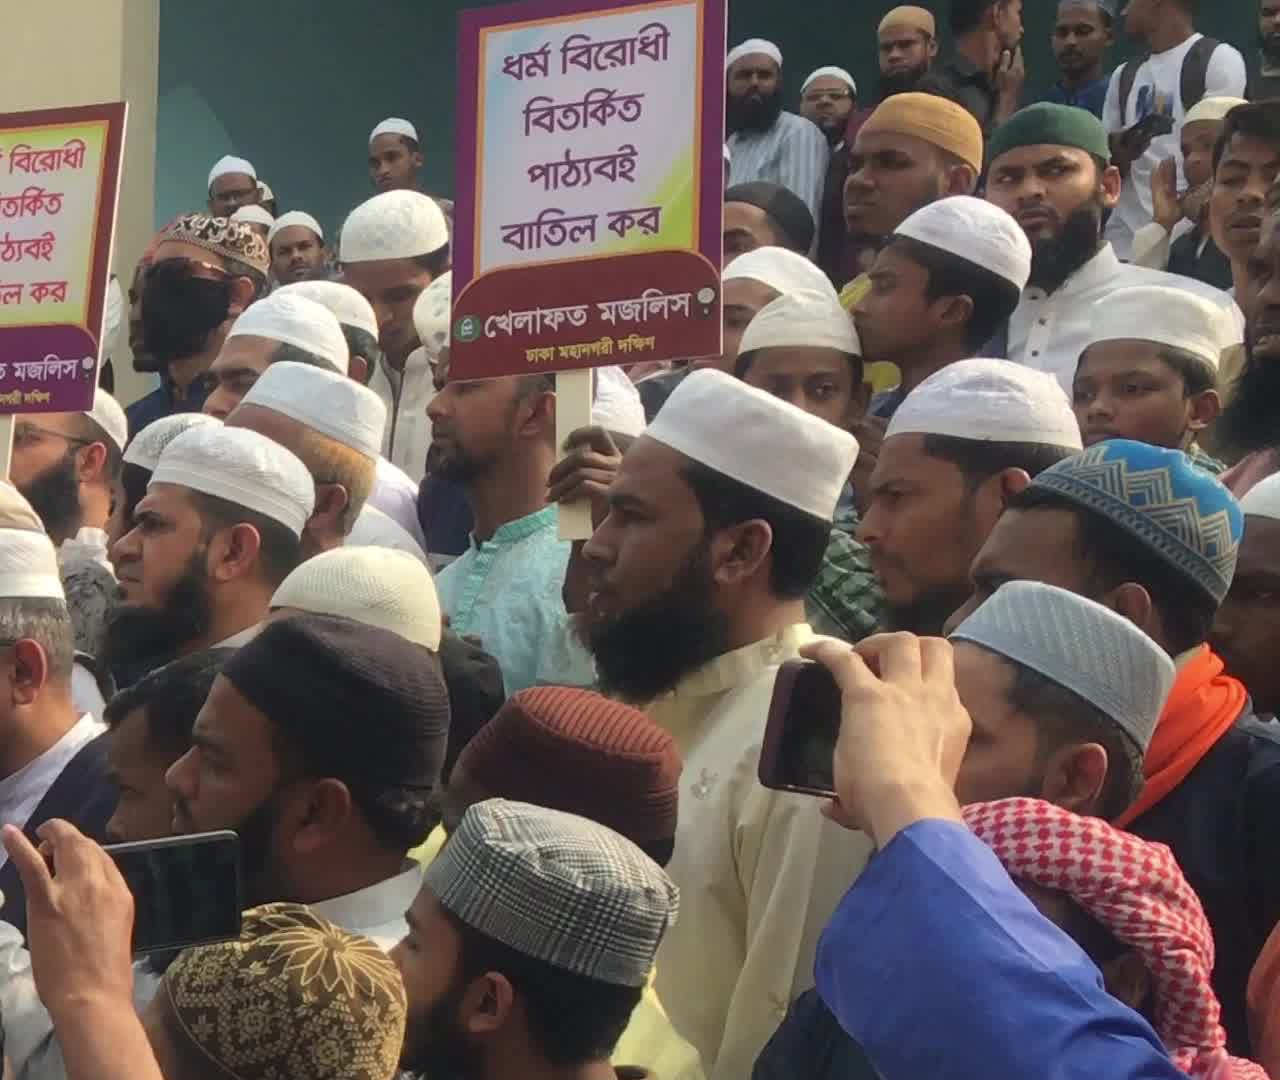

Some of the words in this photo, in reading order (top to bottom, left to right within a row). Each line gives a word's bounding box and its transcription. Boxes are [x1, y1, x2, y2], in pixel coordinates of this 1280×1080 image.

[502, 43, 550, 80] ধর্ম
[561, 22, 670, 74] বিরোধী
[523, 88, 644, 136] বিতর্কিত
[9, 139, 86, 175] বিরোধী
[528, 144, 638, 190] পাঠ্যবই
[500, 209, 598, 250] বাতিল
[608, 206, 662, 238] কর
[30, 280, 68, 304] কর
[485, 304, 588, 338] খেলাফত
[597, 288, 691, 326] মজলিস
[15, 354, 78, 382] মজলিস
